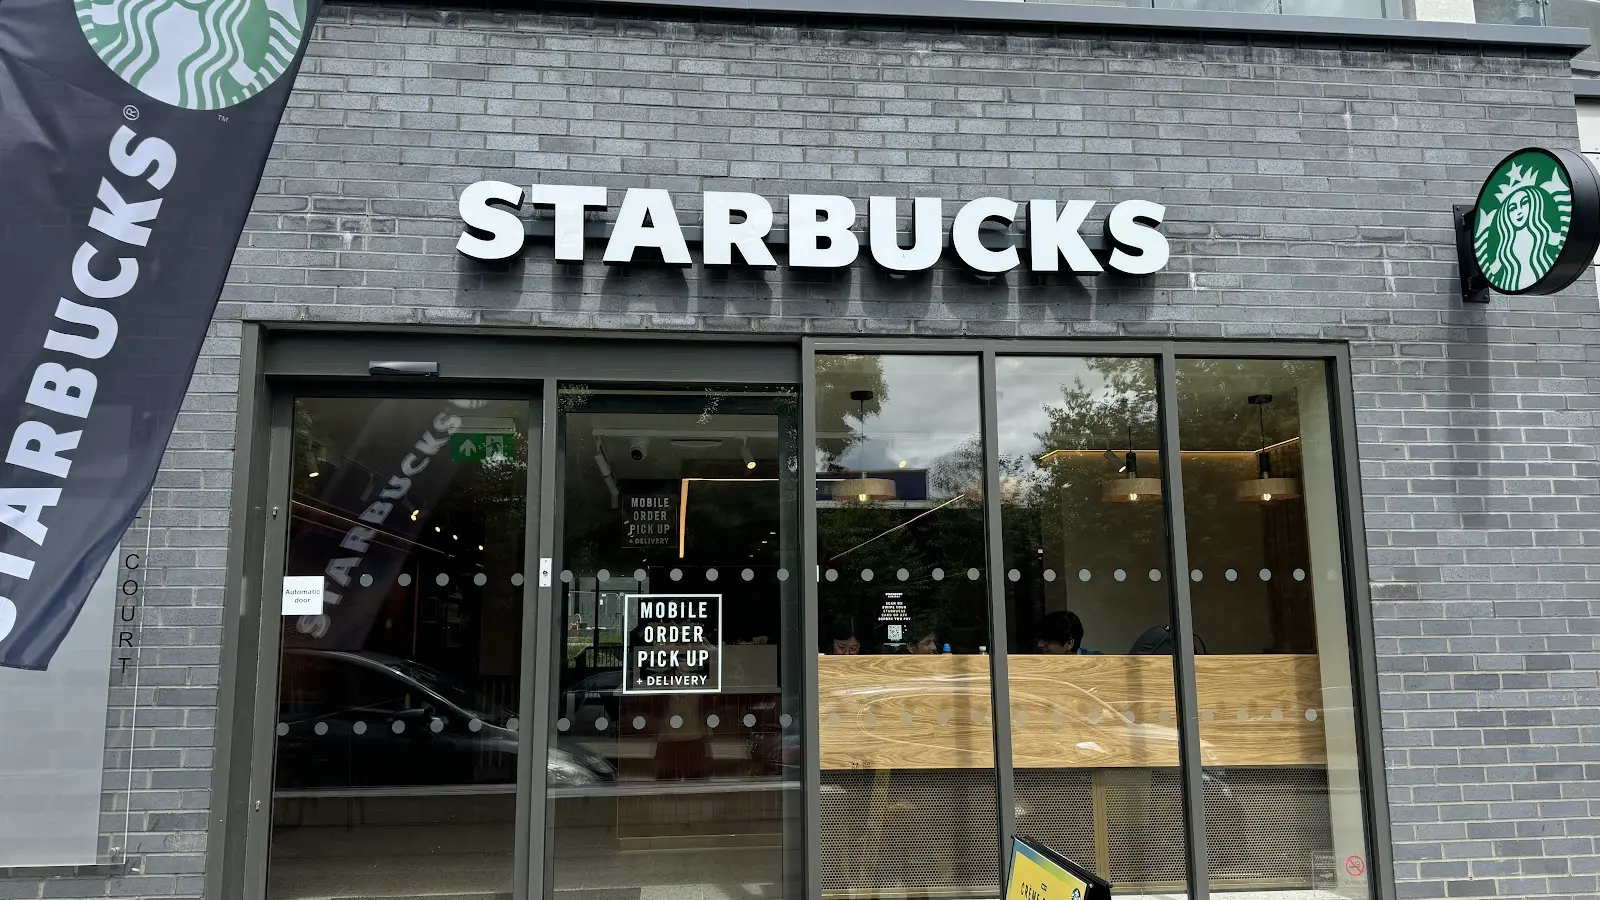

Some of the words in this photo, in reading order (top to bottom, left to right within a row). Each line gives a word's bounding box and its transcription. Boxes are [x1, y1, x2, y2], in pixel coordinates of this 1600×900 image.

[456, 180, 1169, 275] STARBUCKS
[631, 497, 670, 508] MOBILE
[633, 510, 667, 521] ORDER
[629, 523, 654, 534] PICK
[657, 523, 670, 534] UP
[635, 537, 670, 545] DELIVERY
[117, 553, 140, 674] COURT
[640, 601, 708, 619] MOBILE
[644, 625, 704, 643] ORDER
[637, 650, 680, 668] PICK
[686, 649, 709, 667] UP
[646, 675, 708, 686] DELIVERY
